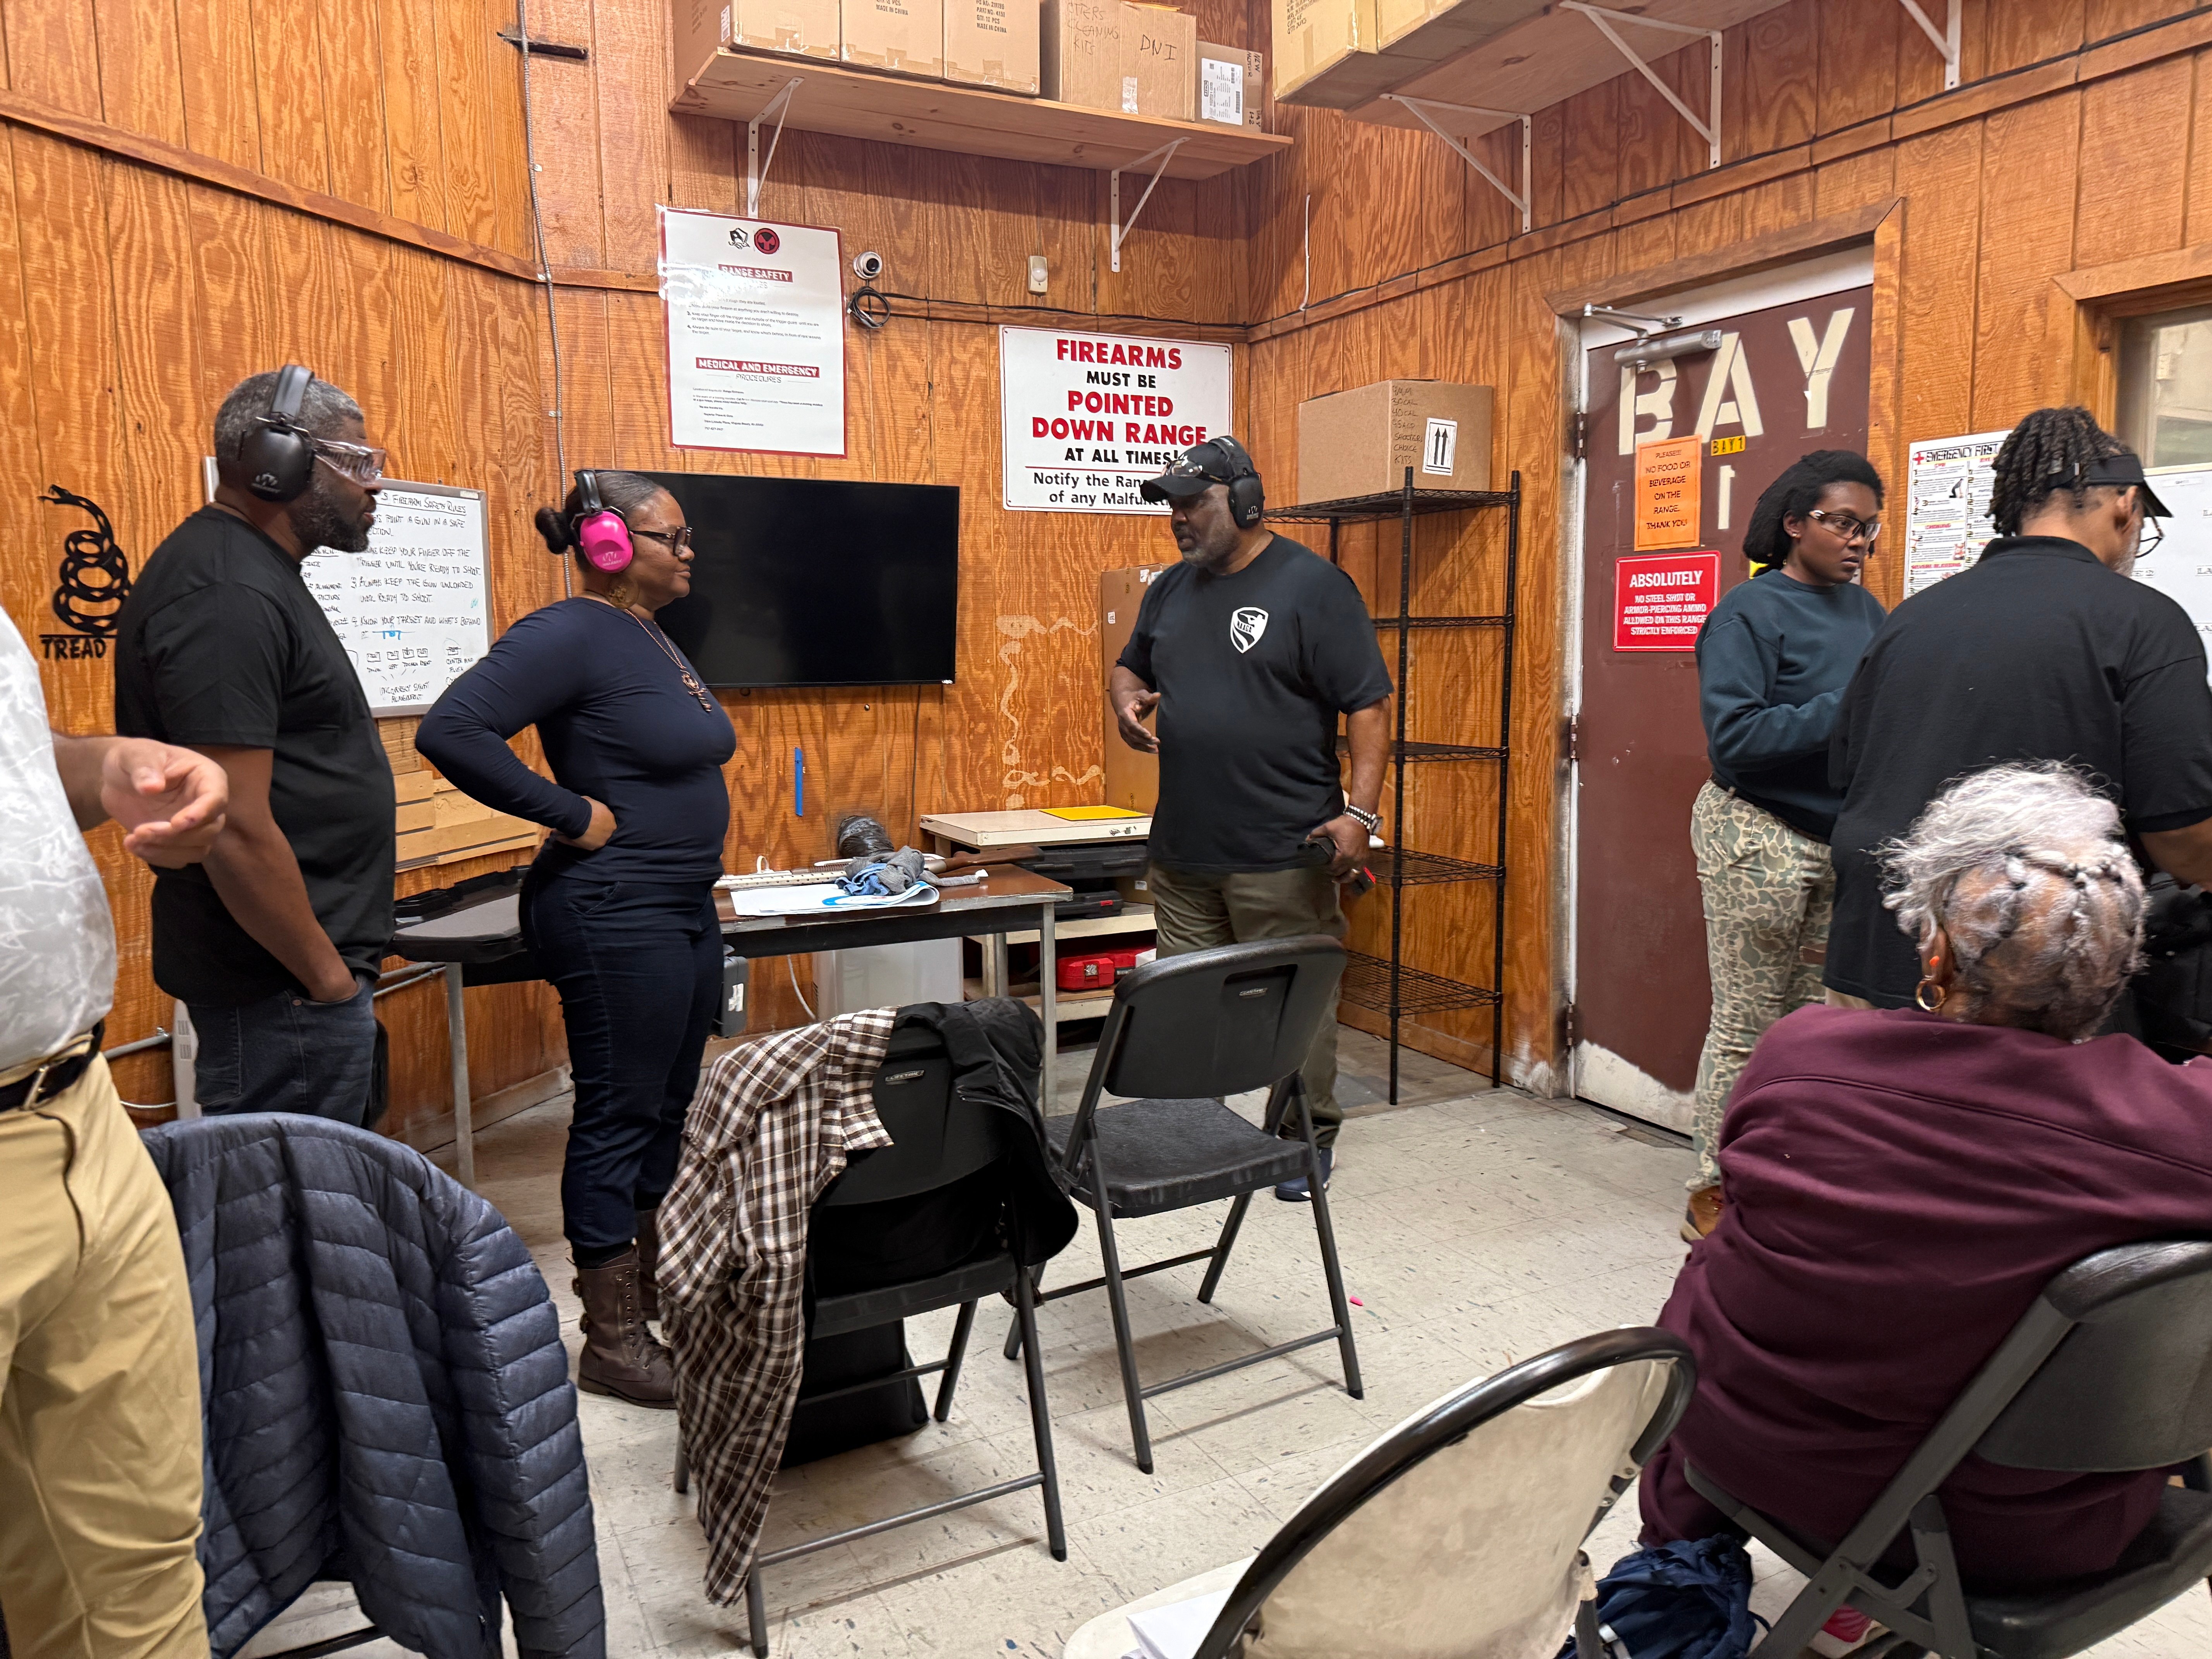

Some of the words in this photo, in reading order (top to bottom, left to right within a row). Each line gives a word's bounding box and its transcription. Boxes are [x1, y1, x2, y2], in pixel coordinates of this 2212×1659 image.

[1068, 19, 1119, 39] CLEANING
[1073, 35, 1096, 55] KITS
[1140, 34, 1177, 60] DNI
[755, 269, 789, 281] SAFETY
[1057, 339, 1182, 370] FIREARMS
[699, 359, 740, 370] MEDICAL
[742, 362, 761, 372] AND
[763, 364, 818, 377] EMERGENCY
[736, 374, 781, 383] PROCEDURES
[1086, 371, 1131, 387] MUST
[1138, 374, 1156, 388] BE
[1619, 308, 1855, 455] BAY
[1068, 390, 1173, 417] POINTED
[1032, 417, 1114, 442] DOWN
[1125, 422, 1208, 447] RANGE
[1394, 444, 1417, 452] CHOICE
[1712, 438, 1735, 454] BAY
[1738, 437, 1743, 450] 1
[1926, 447, 1972, 462] EMERGENCY
[1975, 443, 1998, 456] FIRST
[1065, 448, 1084, 462] AT
[1091, 449, 1119, 463] ALL
[1126, 450, 1178, 465] TIMES!
[1395, 455, 1412, 464] KITS
[1645, 465, 1656, 474] NO
[1657, 463, 1678, 472] FOOD
[1034, 472, 1079, 489] Notify
[1086, 474, 1110, 487] the
[1116, 475, 1148, 488] Ran
[1649, 476, 1686, 487] BEVERAGE
[392, 495, 421, 507] FIREARM
[424, 497, 446, 510] SAFETY
[447, 501, 466, 513] RULES
[1049, 490, 1065, 503] of
[1071, 494, 1096, 507] any
[1718, 465, 1735, 529] 1
[386, 515, 404, 523] POINT
[414, 517, 430, 525] GUN
[449, 519, 465, 528] SAFE
[1646, 521, 1670, 529] THANK
[1672, 519, 1688, 527] YOU
[399, 547, 416, 556] YOUR
[419, 548, 440, 556] FINGER
[429, 563, 449, 574] READY
[359, 577, 382, 587] ALWAYS
[422, 579, 437, 587] GUN
[1629, 570, 1703, 588] ABSOLUTELY
[378, 593, 397, 603] READY
[400, 593, 409, 601] TO
[1635, 595, 1644, 603] NO
[1645, 594, 1665, 603] STEEL
[1666, 593, 1684, 602] SHOT
[1685, 593, 1696, 601] OR
[1624, 605, 1682, 614] ARMOR-PIERCING
[1683, 604, 1707, 612] AMMO
[361, 616, 378, 626] KNOW
[381, 616, 395, 625] YOUR
[396, 615, 422, 624] TARGET
[460, 617, 481, 626] BEHIND
[1237, 620, 1252, 633] NAAGA
[1623, 616, 1654, 625] ALLOWED
[1655, 616, 1665, 624] ON
[1665, 615, 1681, 623] THIS
[1682, 614, 1707, 623] RANGE
[1631, 627, 1659, 635] STRICTLY
[1661, 626, 1698, 635] ENFORCED
[40, 638, 106, 659] TREAD
[380, 684, 411, 696] INCORRECT
[414, 681, 430, 692] SIGHT
[392, 694, 423, 703] ALIGNMENT
